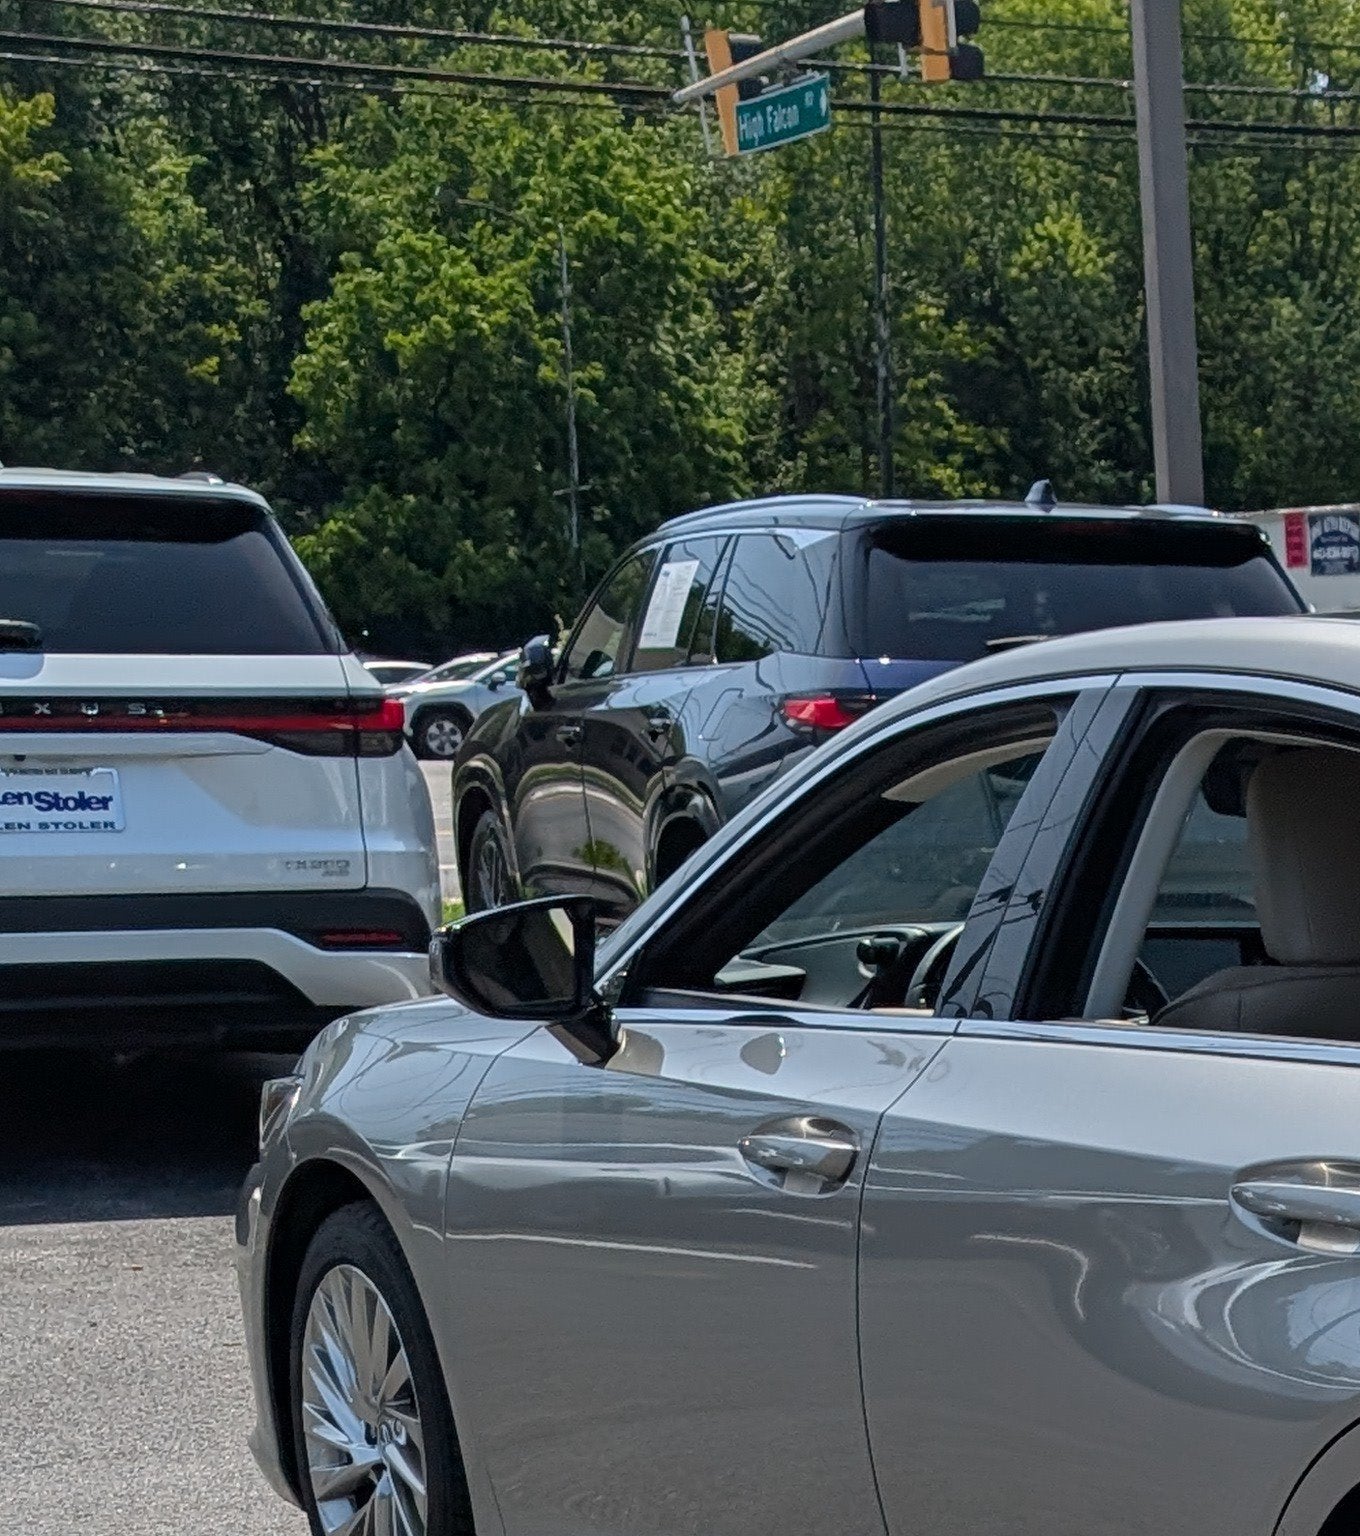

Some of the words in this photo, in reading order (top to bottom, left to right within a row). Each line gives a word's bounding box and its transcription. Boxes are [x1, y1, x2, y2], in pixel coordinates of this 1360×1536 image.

[738, 111, 764, 147] High
[766, 104, 800, 133] Falcon
[0, 702, 147, 715] XUS
[37, 820, 117, 831] STOLER
